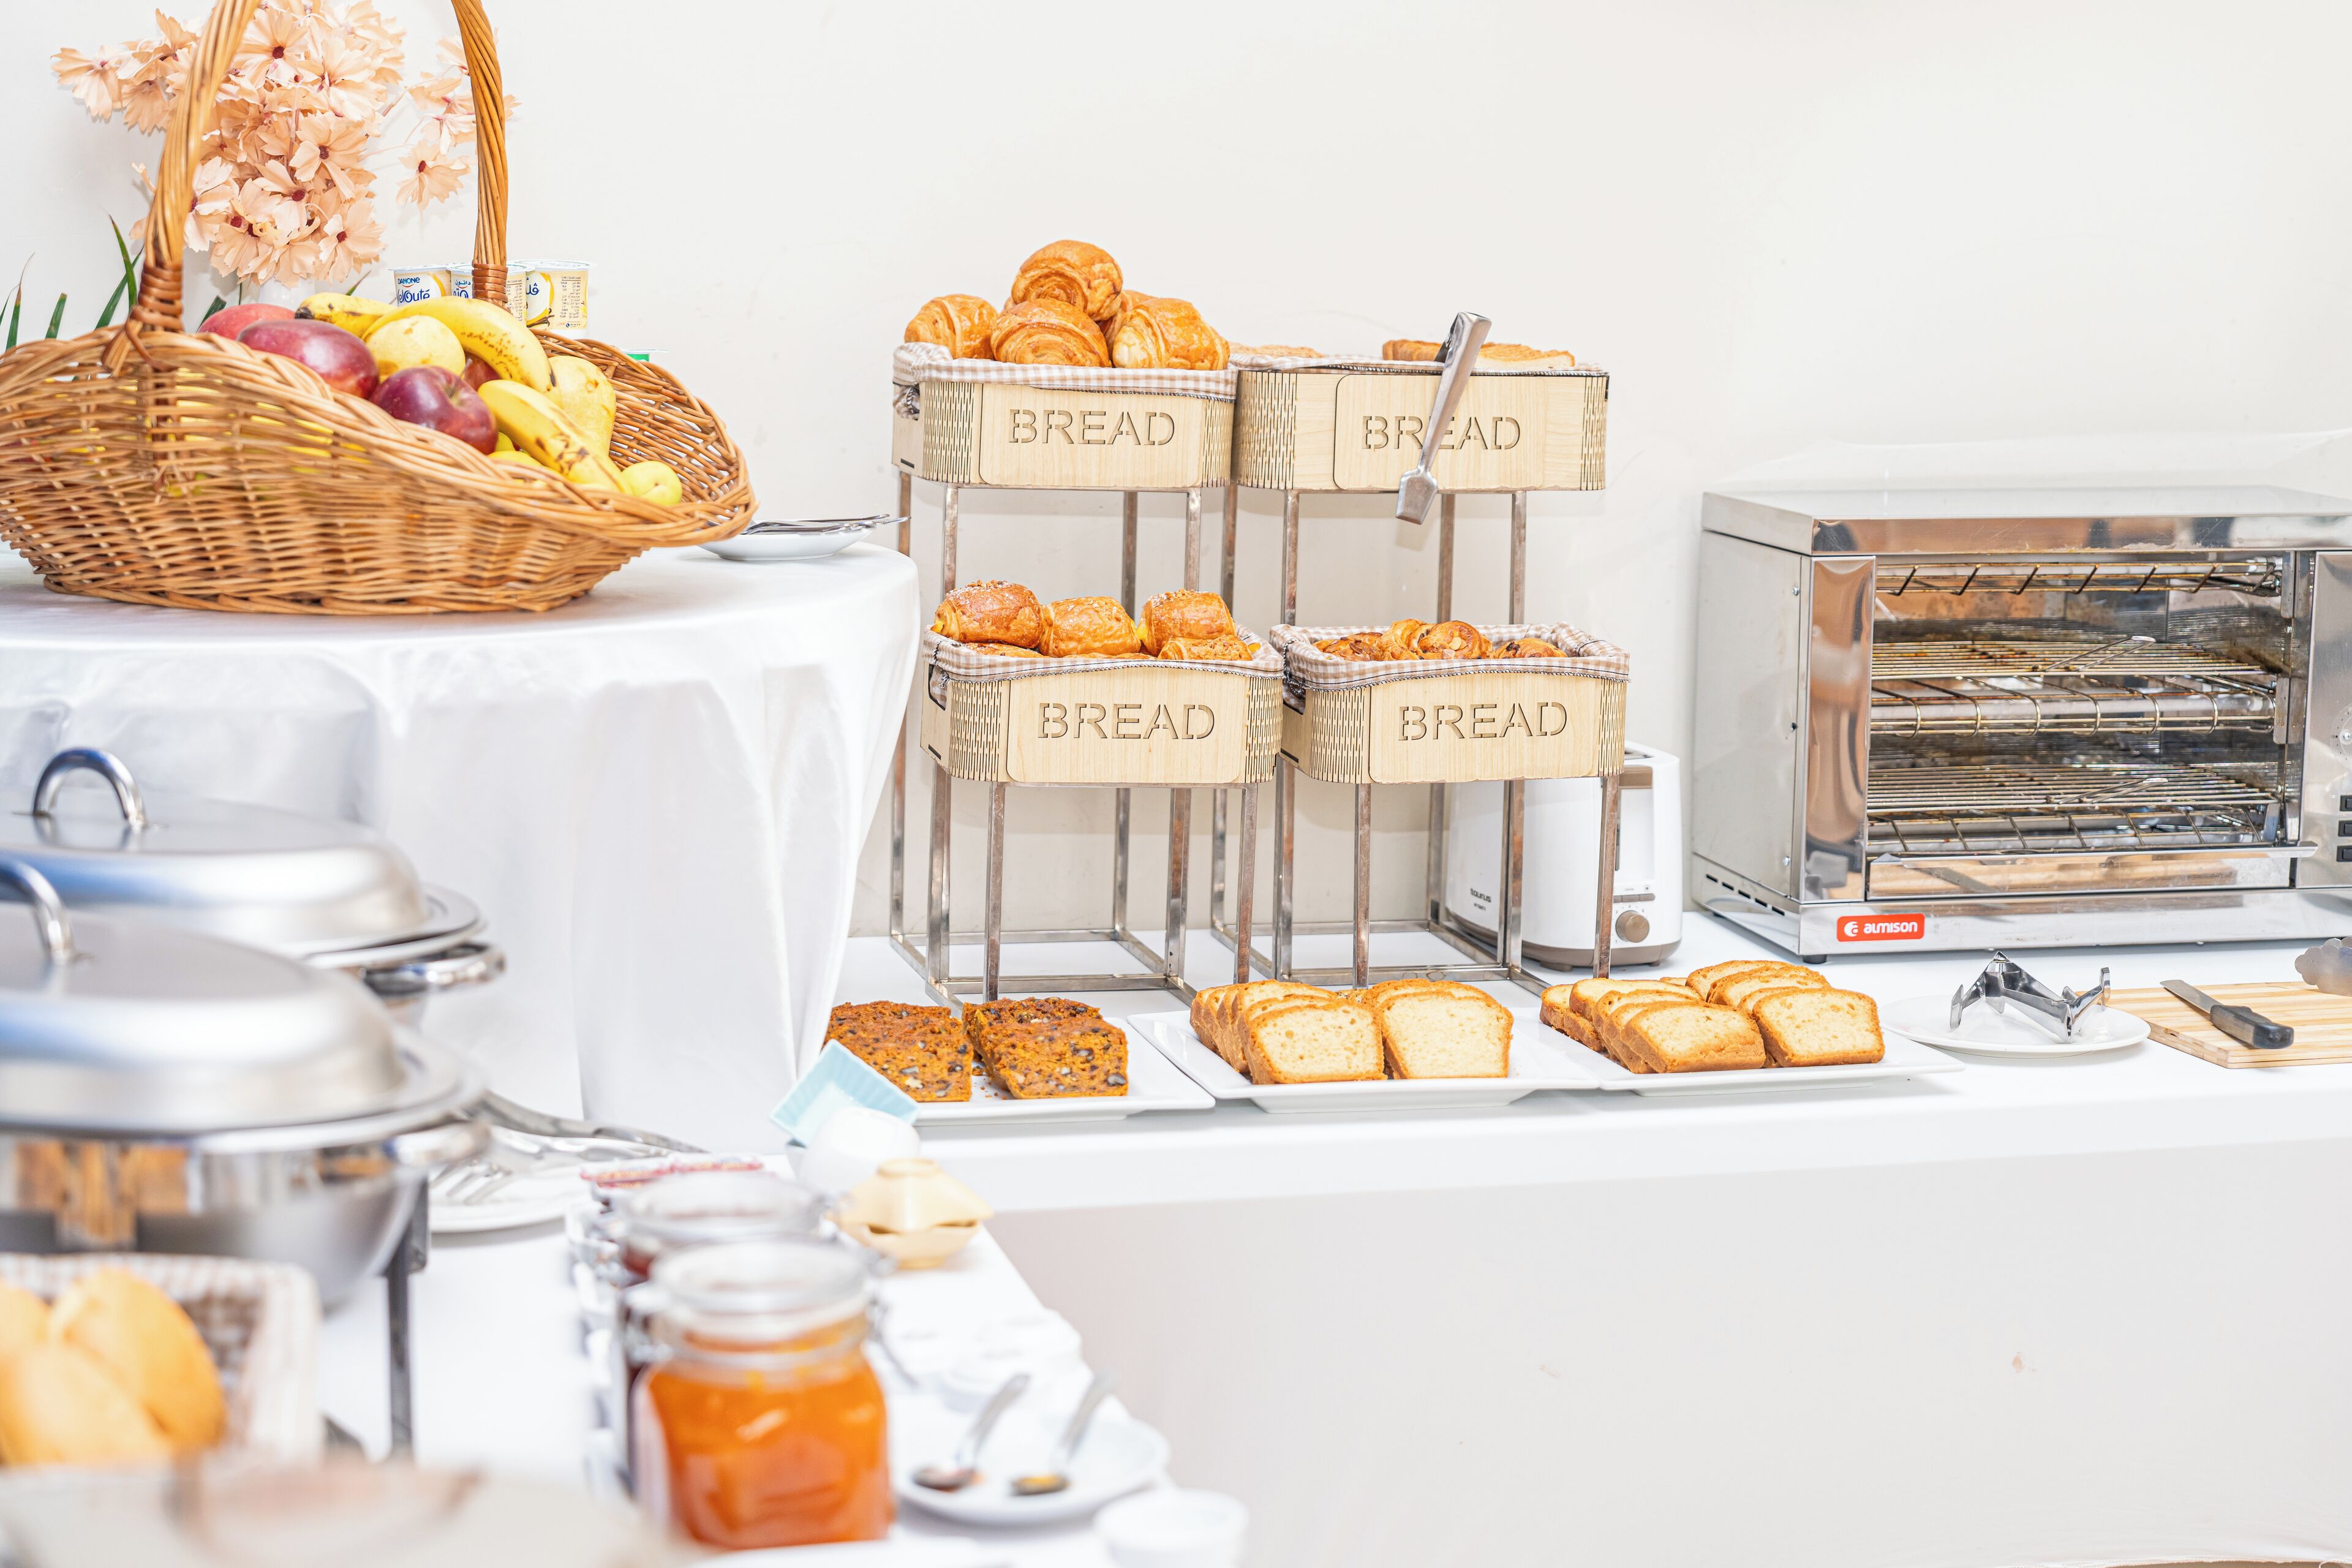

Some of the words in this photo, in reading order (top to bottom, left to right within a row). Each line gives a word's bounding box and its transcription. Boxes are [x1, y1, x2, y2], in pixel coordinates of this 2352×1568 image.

[1009, 409, 1175, 446] BREAD
[1362, 415, 1521, 450] BREAD
[1038, 703, 1215, 739] BREAD
[1398, 701, 1568, 741] BREAD
[1863, 921, 1918, 934] almison
